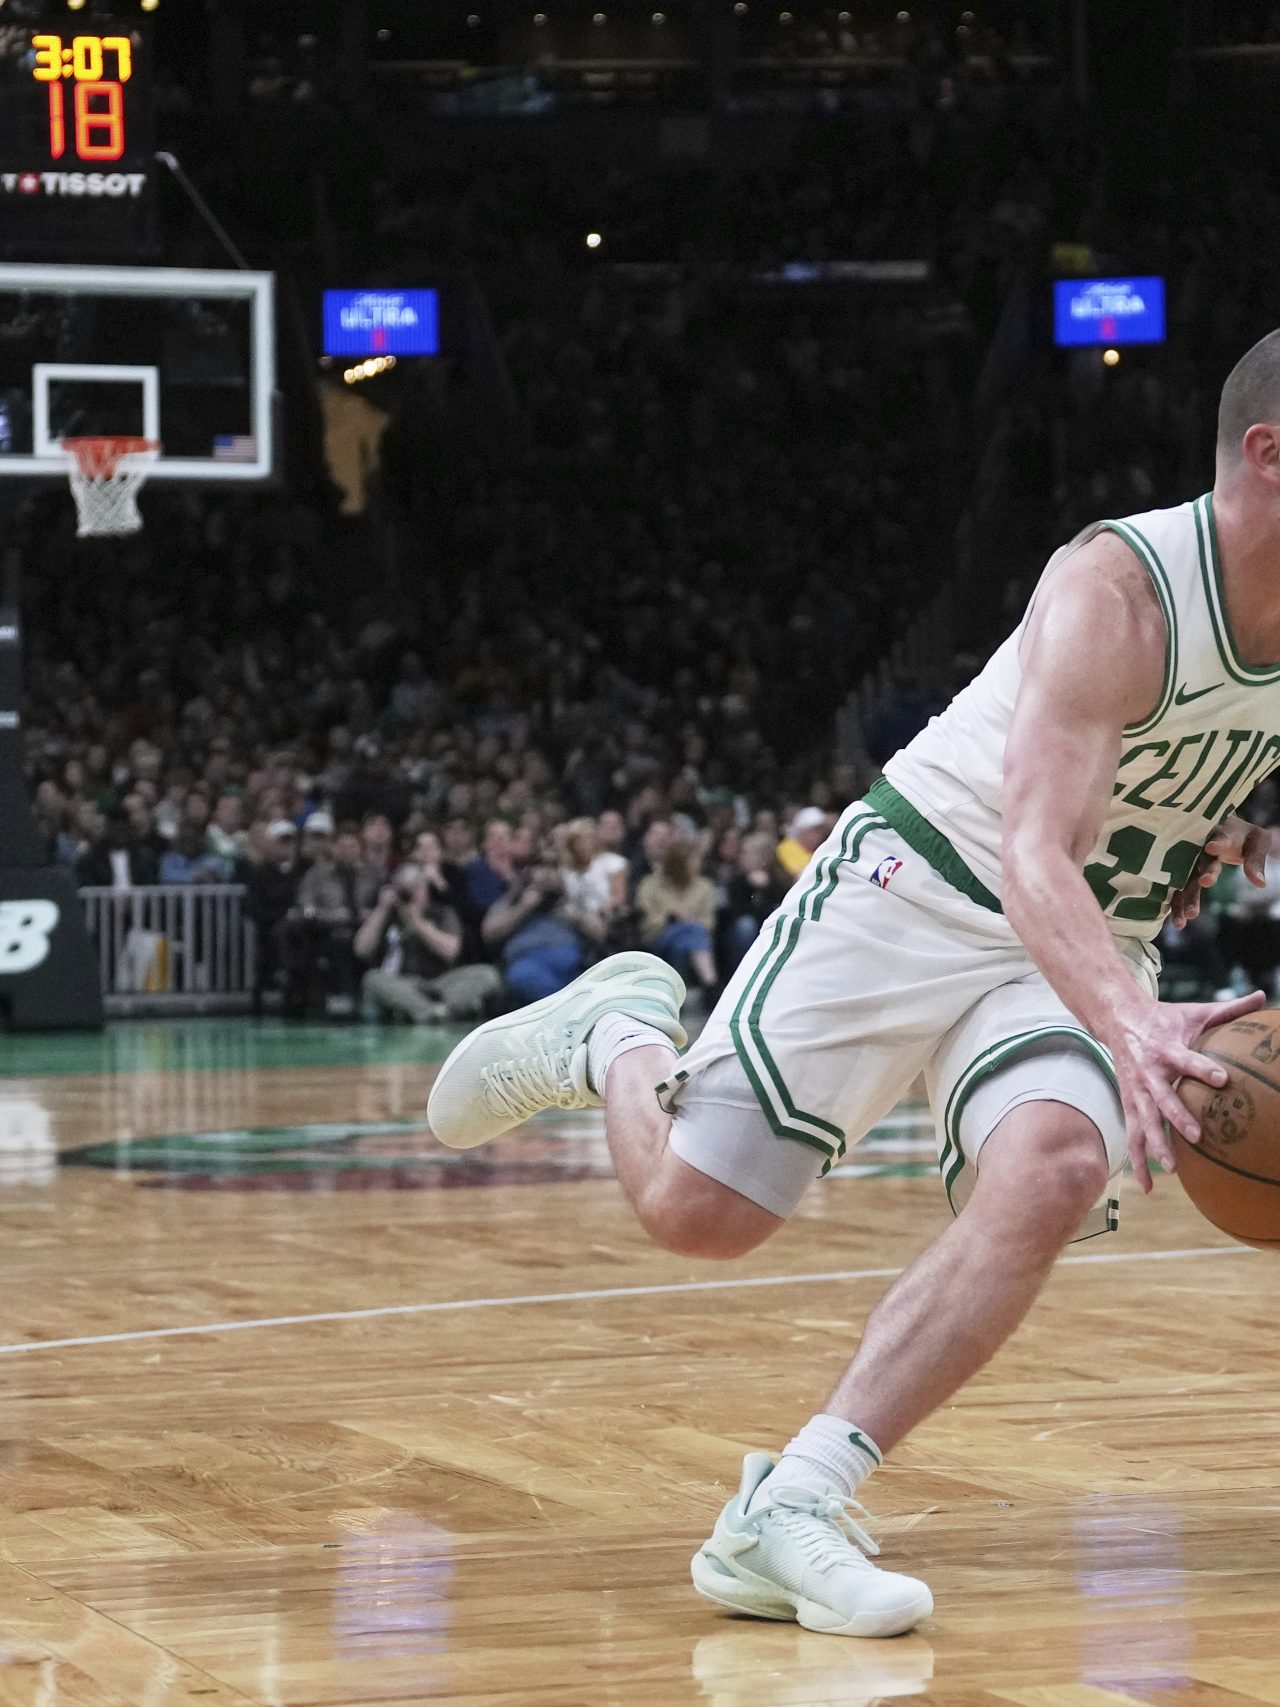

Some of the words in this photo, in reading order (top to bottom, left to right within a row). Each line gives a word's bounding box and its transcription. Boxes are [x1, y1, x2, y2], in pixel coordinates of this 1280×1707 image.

[32, 35, 131, 82] 3:07
[49, 81, 124, 160] 18
[43, 173, 145, 196] TISSOT
